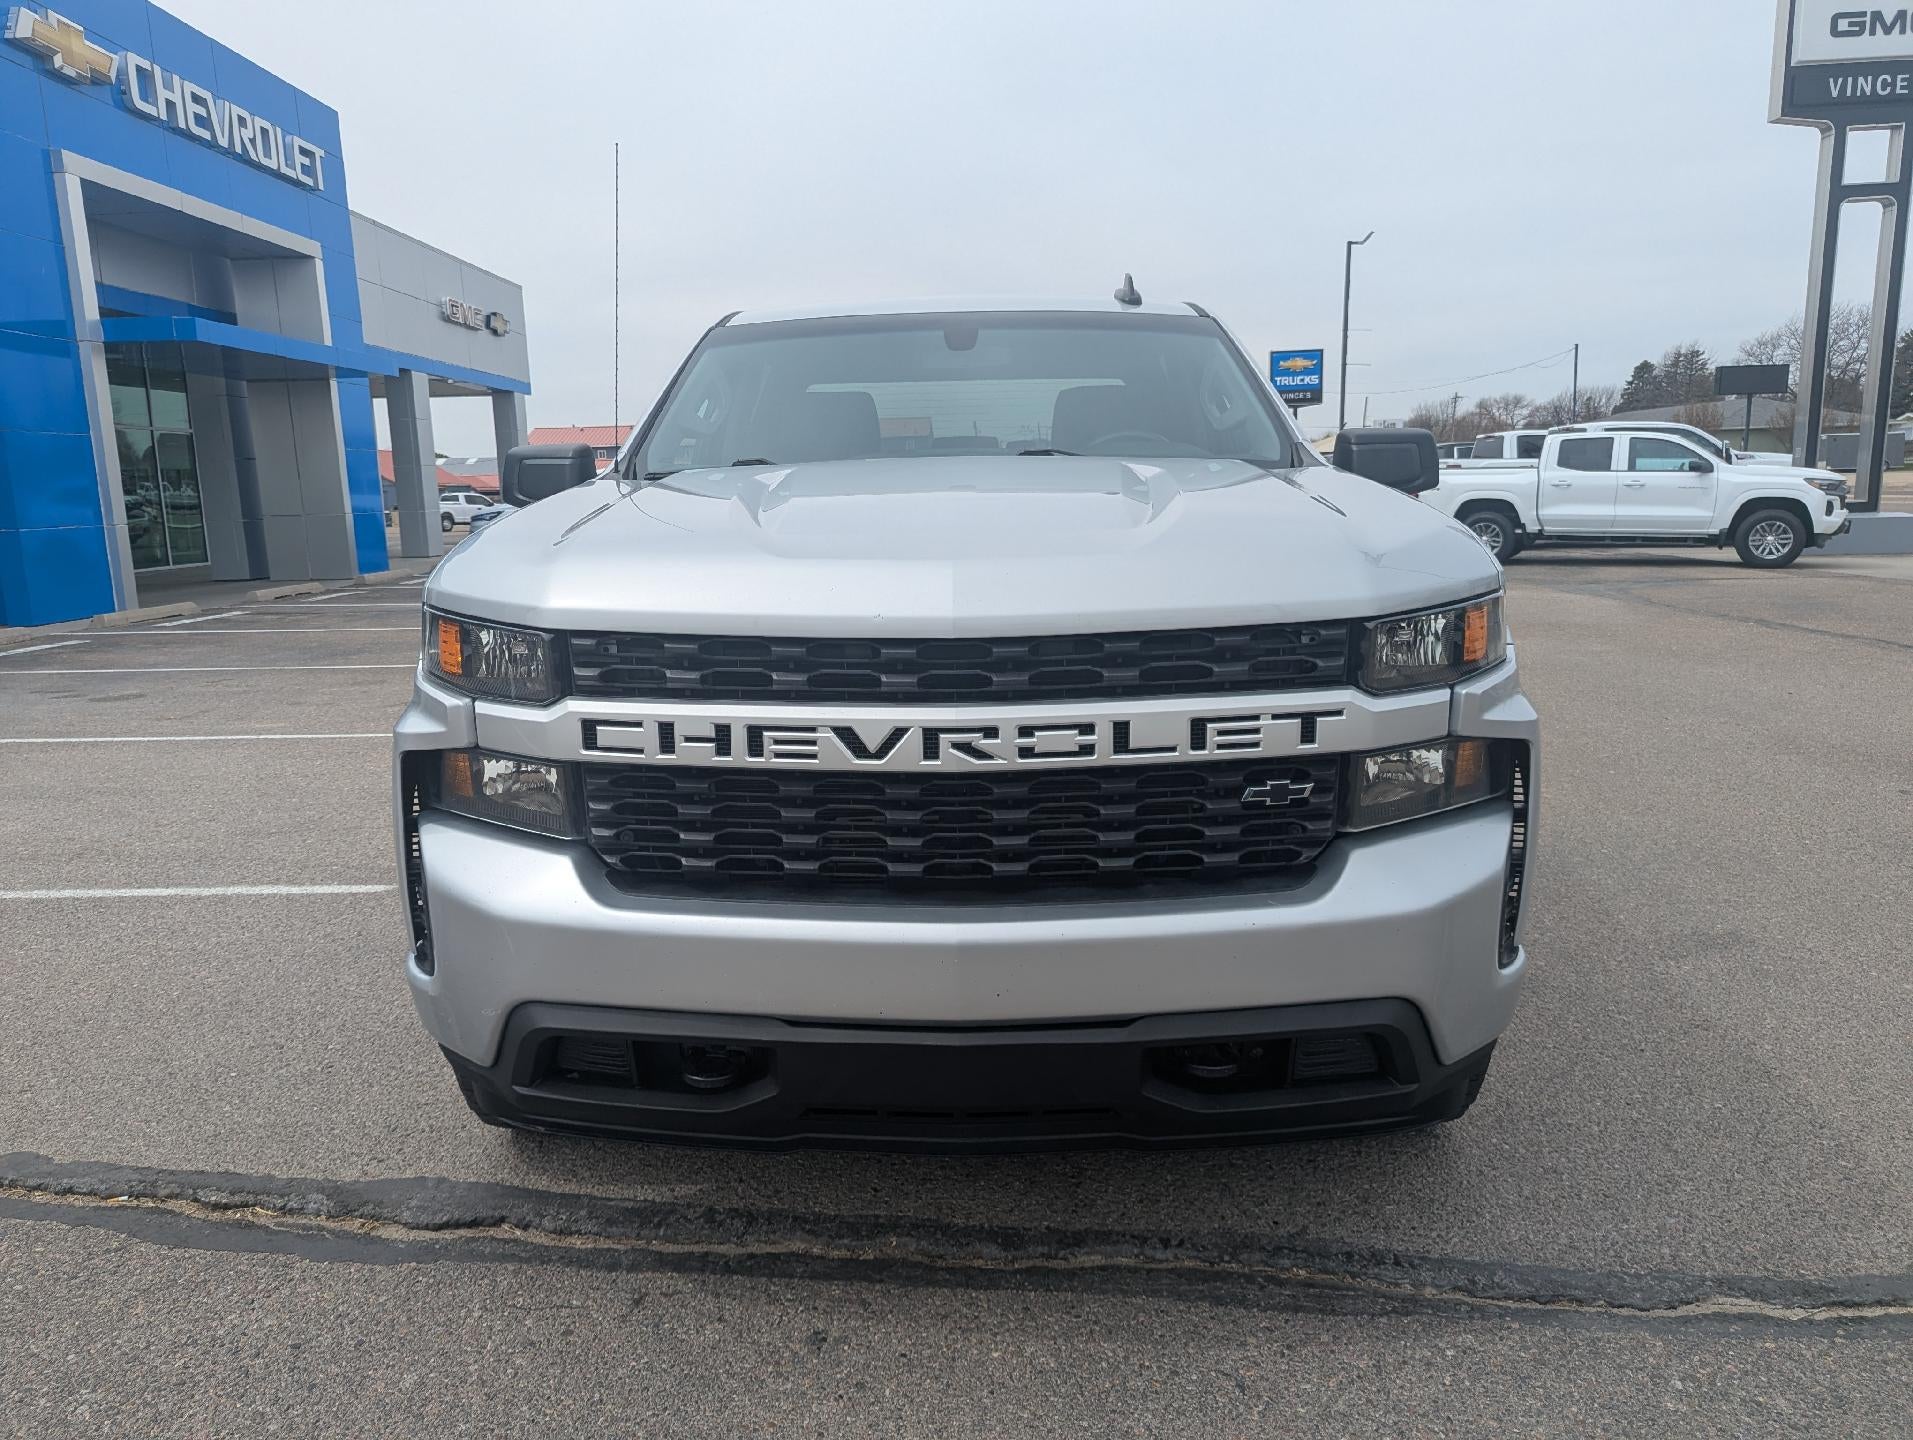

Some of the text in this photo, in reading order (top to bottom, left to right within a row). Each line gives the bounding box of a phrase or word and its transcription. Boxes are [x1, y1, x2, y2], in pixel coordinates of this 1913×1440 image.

[1829, 9, 1913, 38] GM
[125, 51, 325, 191] CHEVROLET
[1274, 375, 1319, 386] TRUCKS
[579, 708, 1347, 764] CHEVROLET
